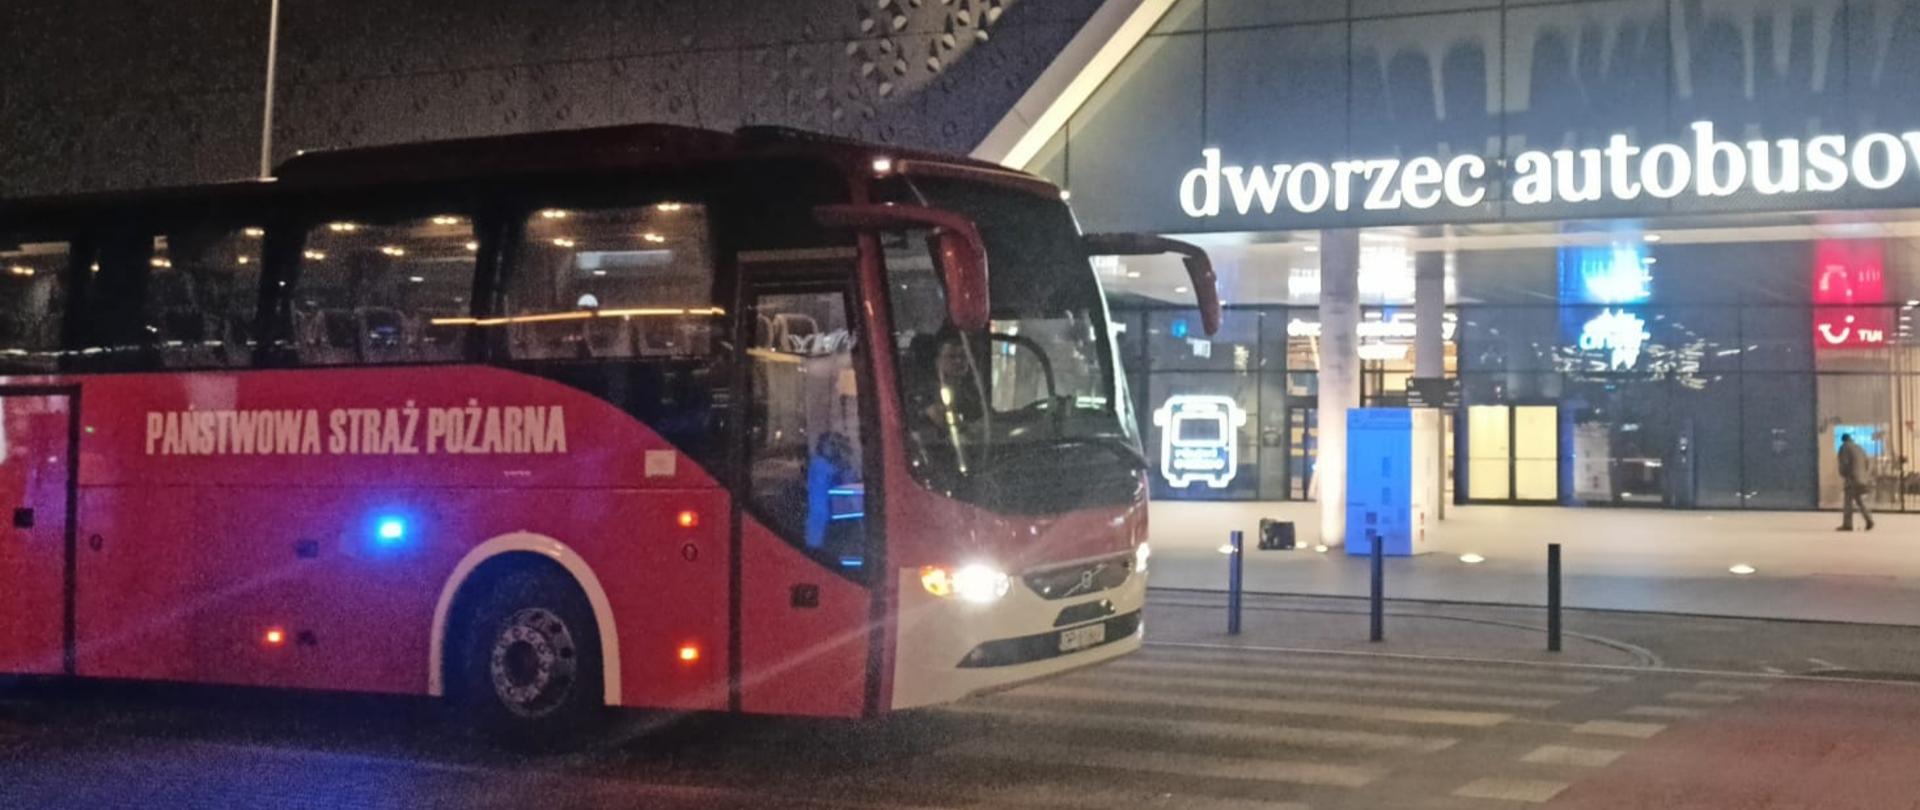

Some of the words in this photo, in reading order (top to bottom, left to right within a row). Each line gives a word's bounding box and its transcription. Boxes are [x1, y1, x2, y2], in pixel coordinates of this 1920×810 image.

[1179, 148, 1486, 218] dworzec
[1857, 328, 1883, 342] TUI
[146, 404, 321, 455] PAŃSTWOWA
[329, 400, 419, 455] STRAŻ
[426, 398, 568, 454] POŻARNA
